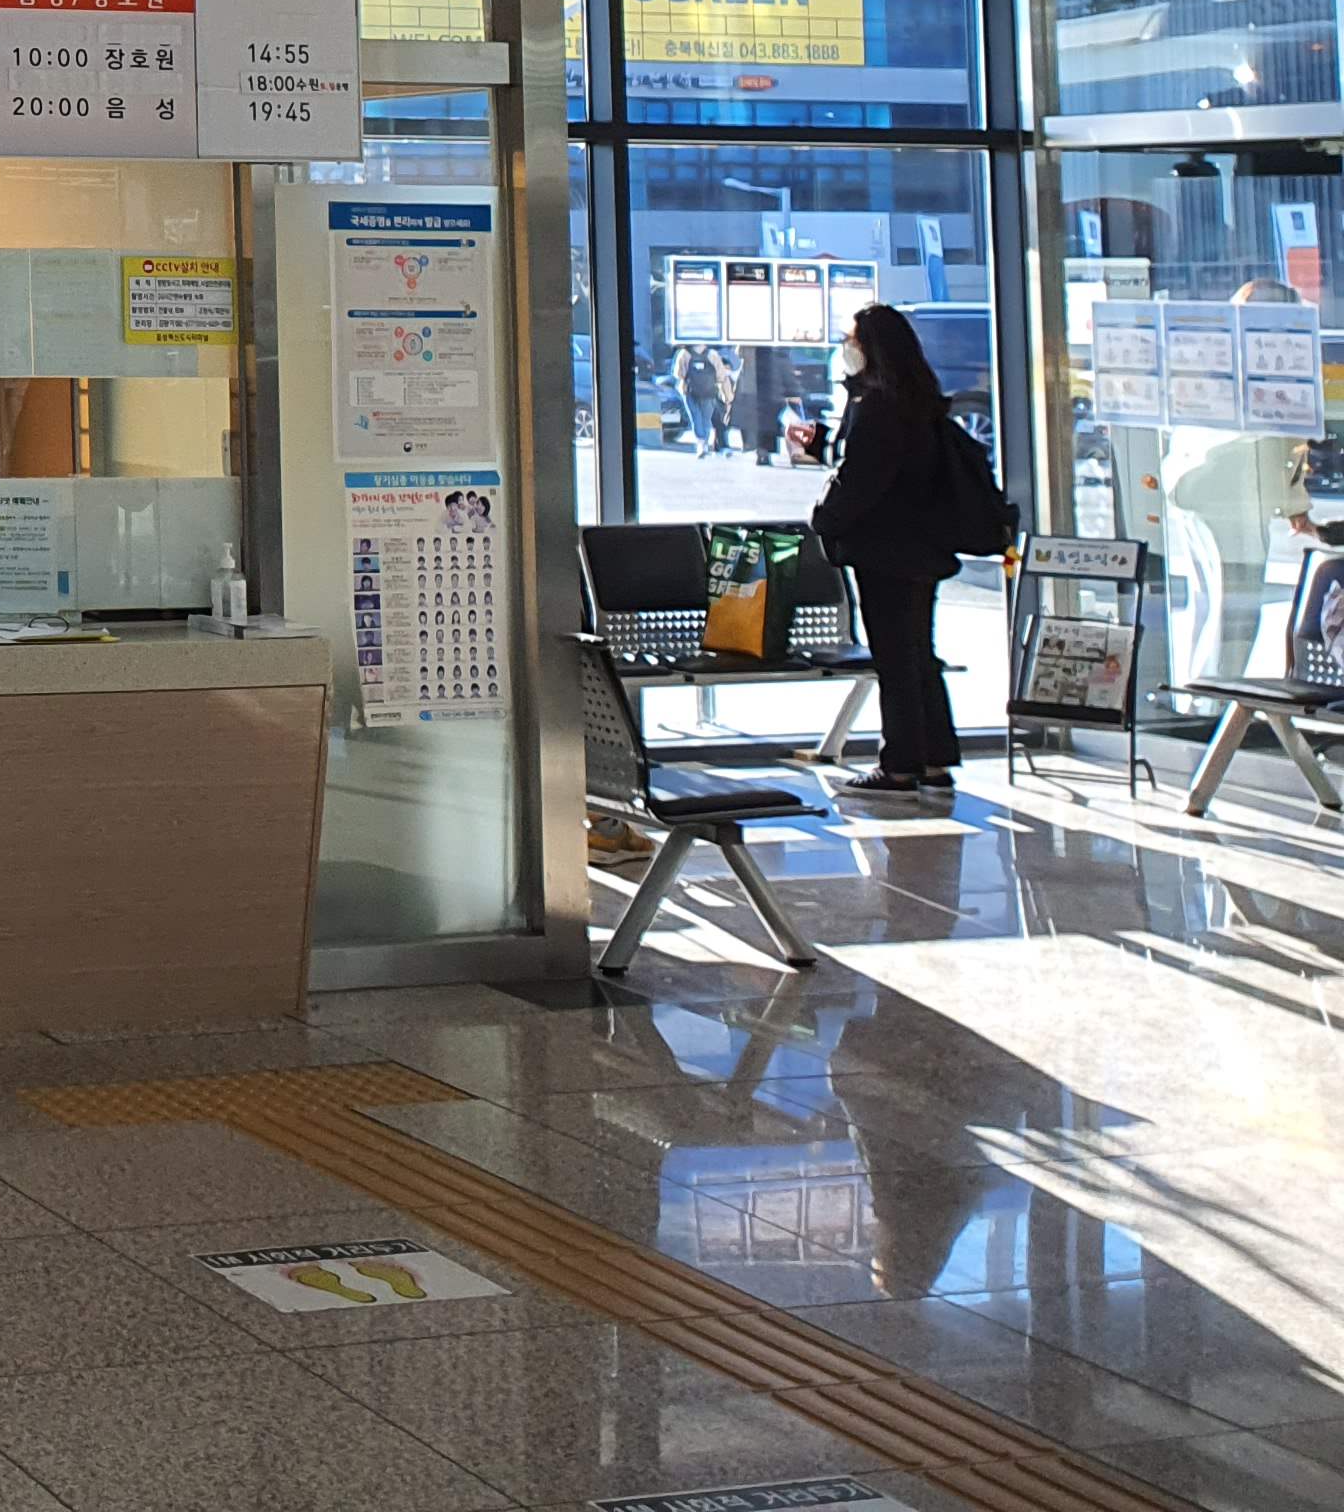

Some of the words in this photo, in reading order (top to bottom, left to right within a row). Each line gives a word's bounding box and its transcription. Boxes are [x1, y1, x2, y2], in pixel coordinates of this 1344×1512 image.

[13, 48, 87, 67] 10:00
[106, 49, 173, 70] 장호원
[248, 44, 308, 63] 14:55
[13, 97, 88, 116] 20:00
[250, 102, 310, 121] 19:45
